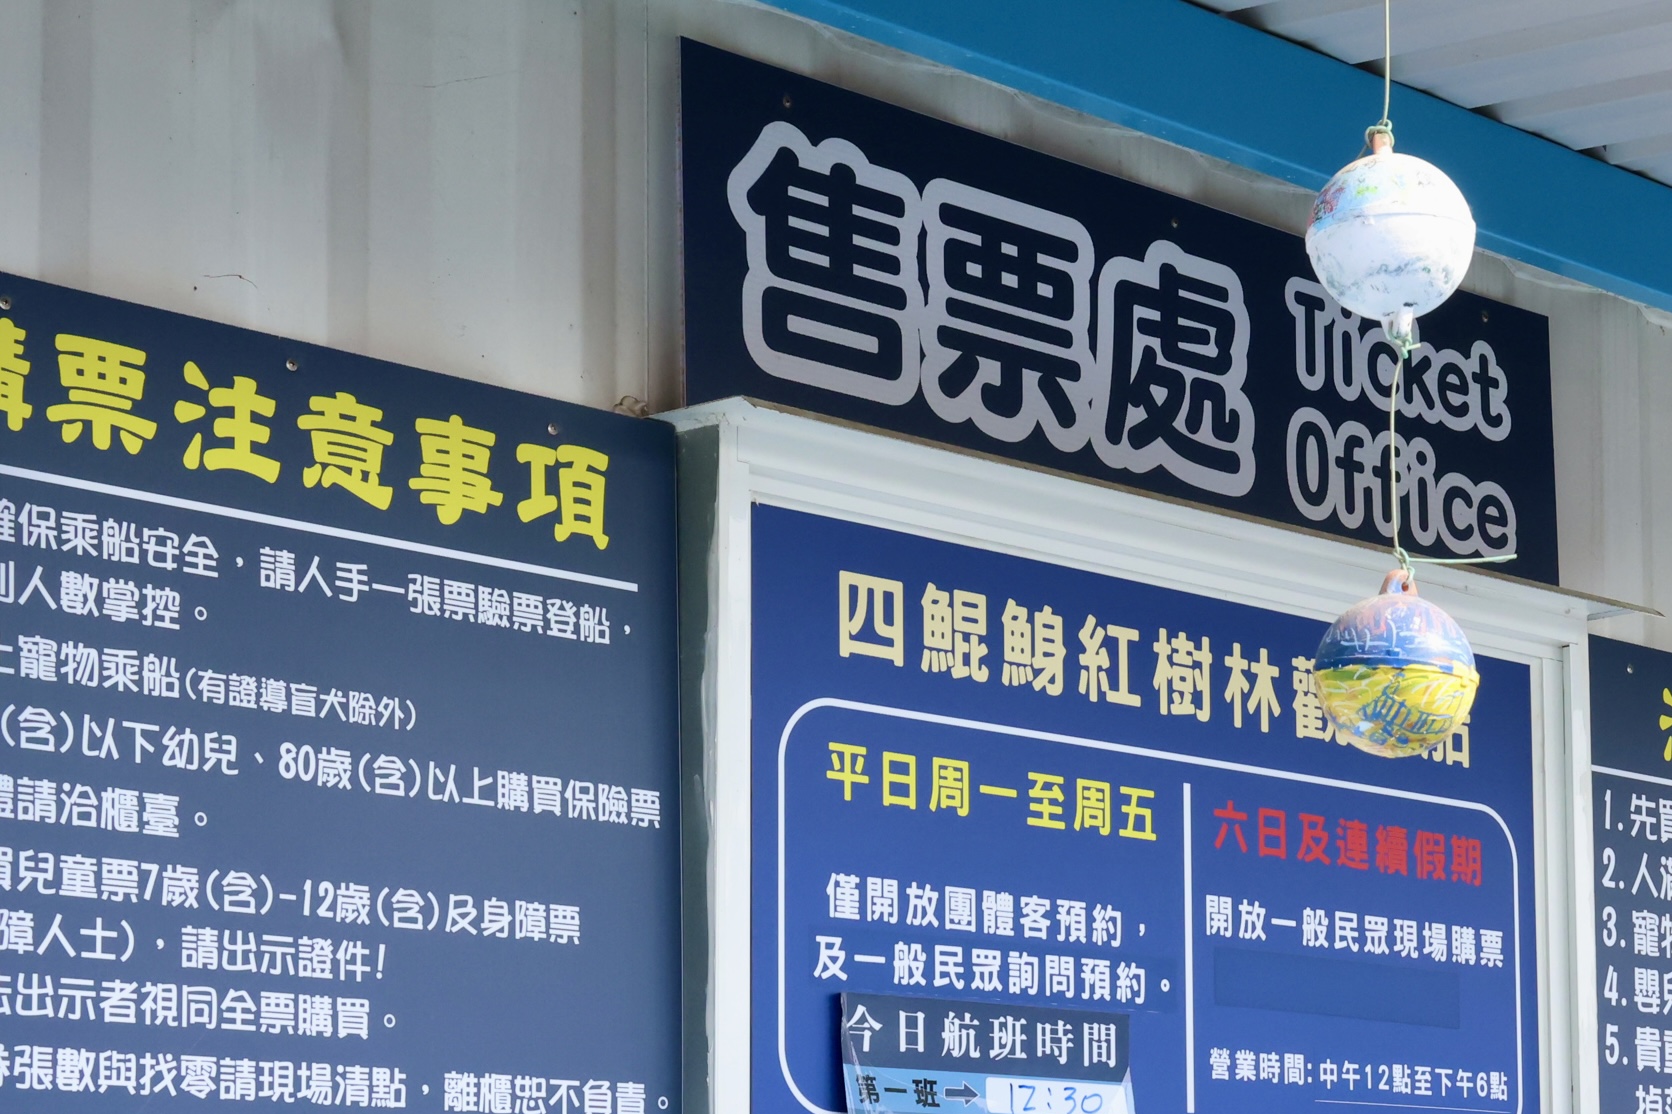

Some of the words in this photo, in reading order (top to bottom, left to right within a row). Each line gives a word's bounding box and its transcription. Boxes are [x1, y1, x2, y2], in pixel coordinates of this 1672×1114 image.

[727, 119, 1255, 497] 售票處
[1285, 276, 1512, 441] Ticket
[1287, 407, 1517, 562] Office
[826, 741, 1157, 842] 平日周一至周五
[1213, 799, 1483, 887] 六日及連續假期
[813, 934, 1171, 1005] 及一般民眾詢問預約。
[1205, 893, 1505, 968] 開放一般民眾現場購票
[846, 1003, 1118, 1069] 今日航班時間
[855, 1074, 941, 1109] 第一班
